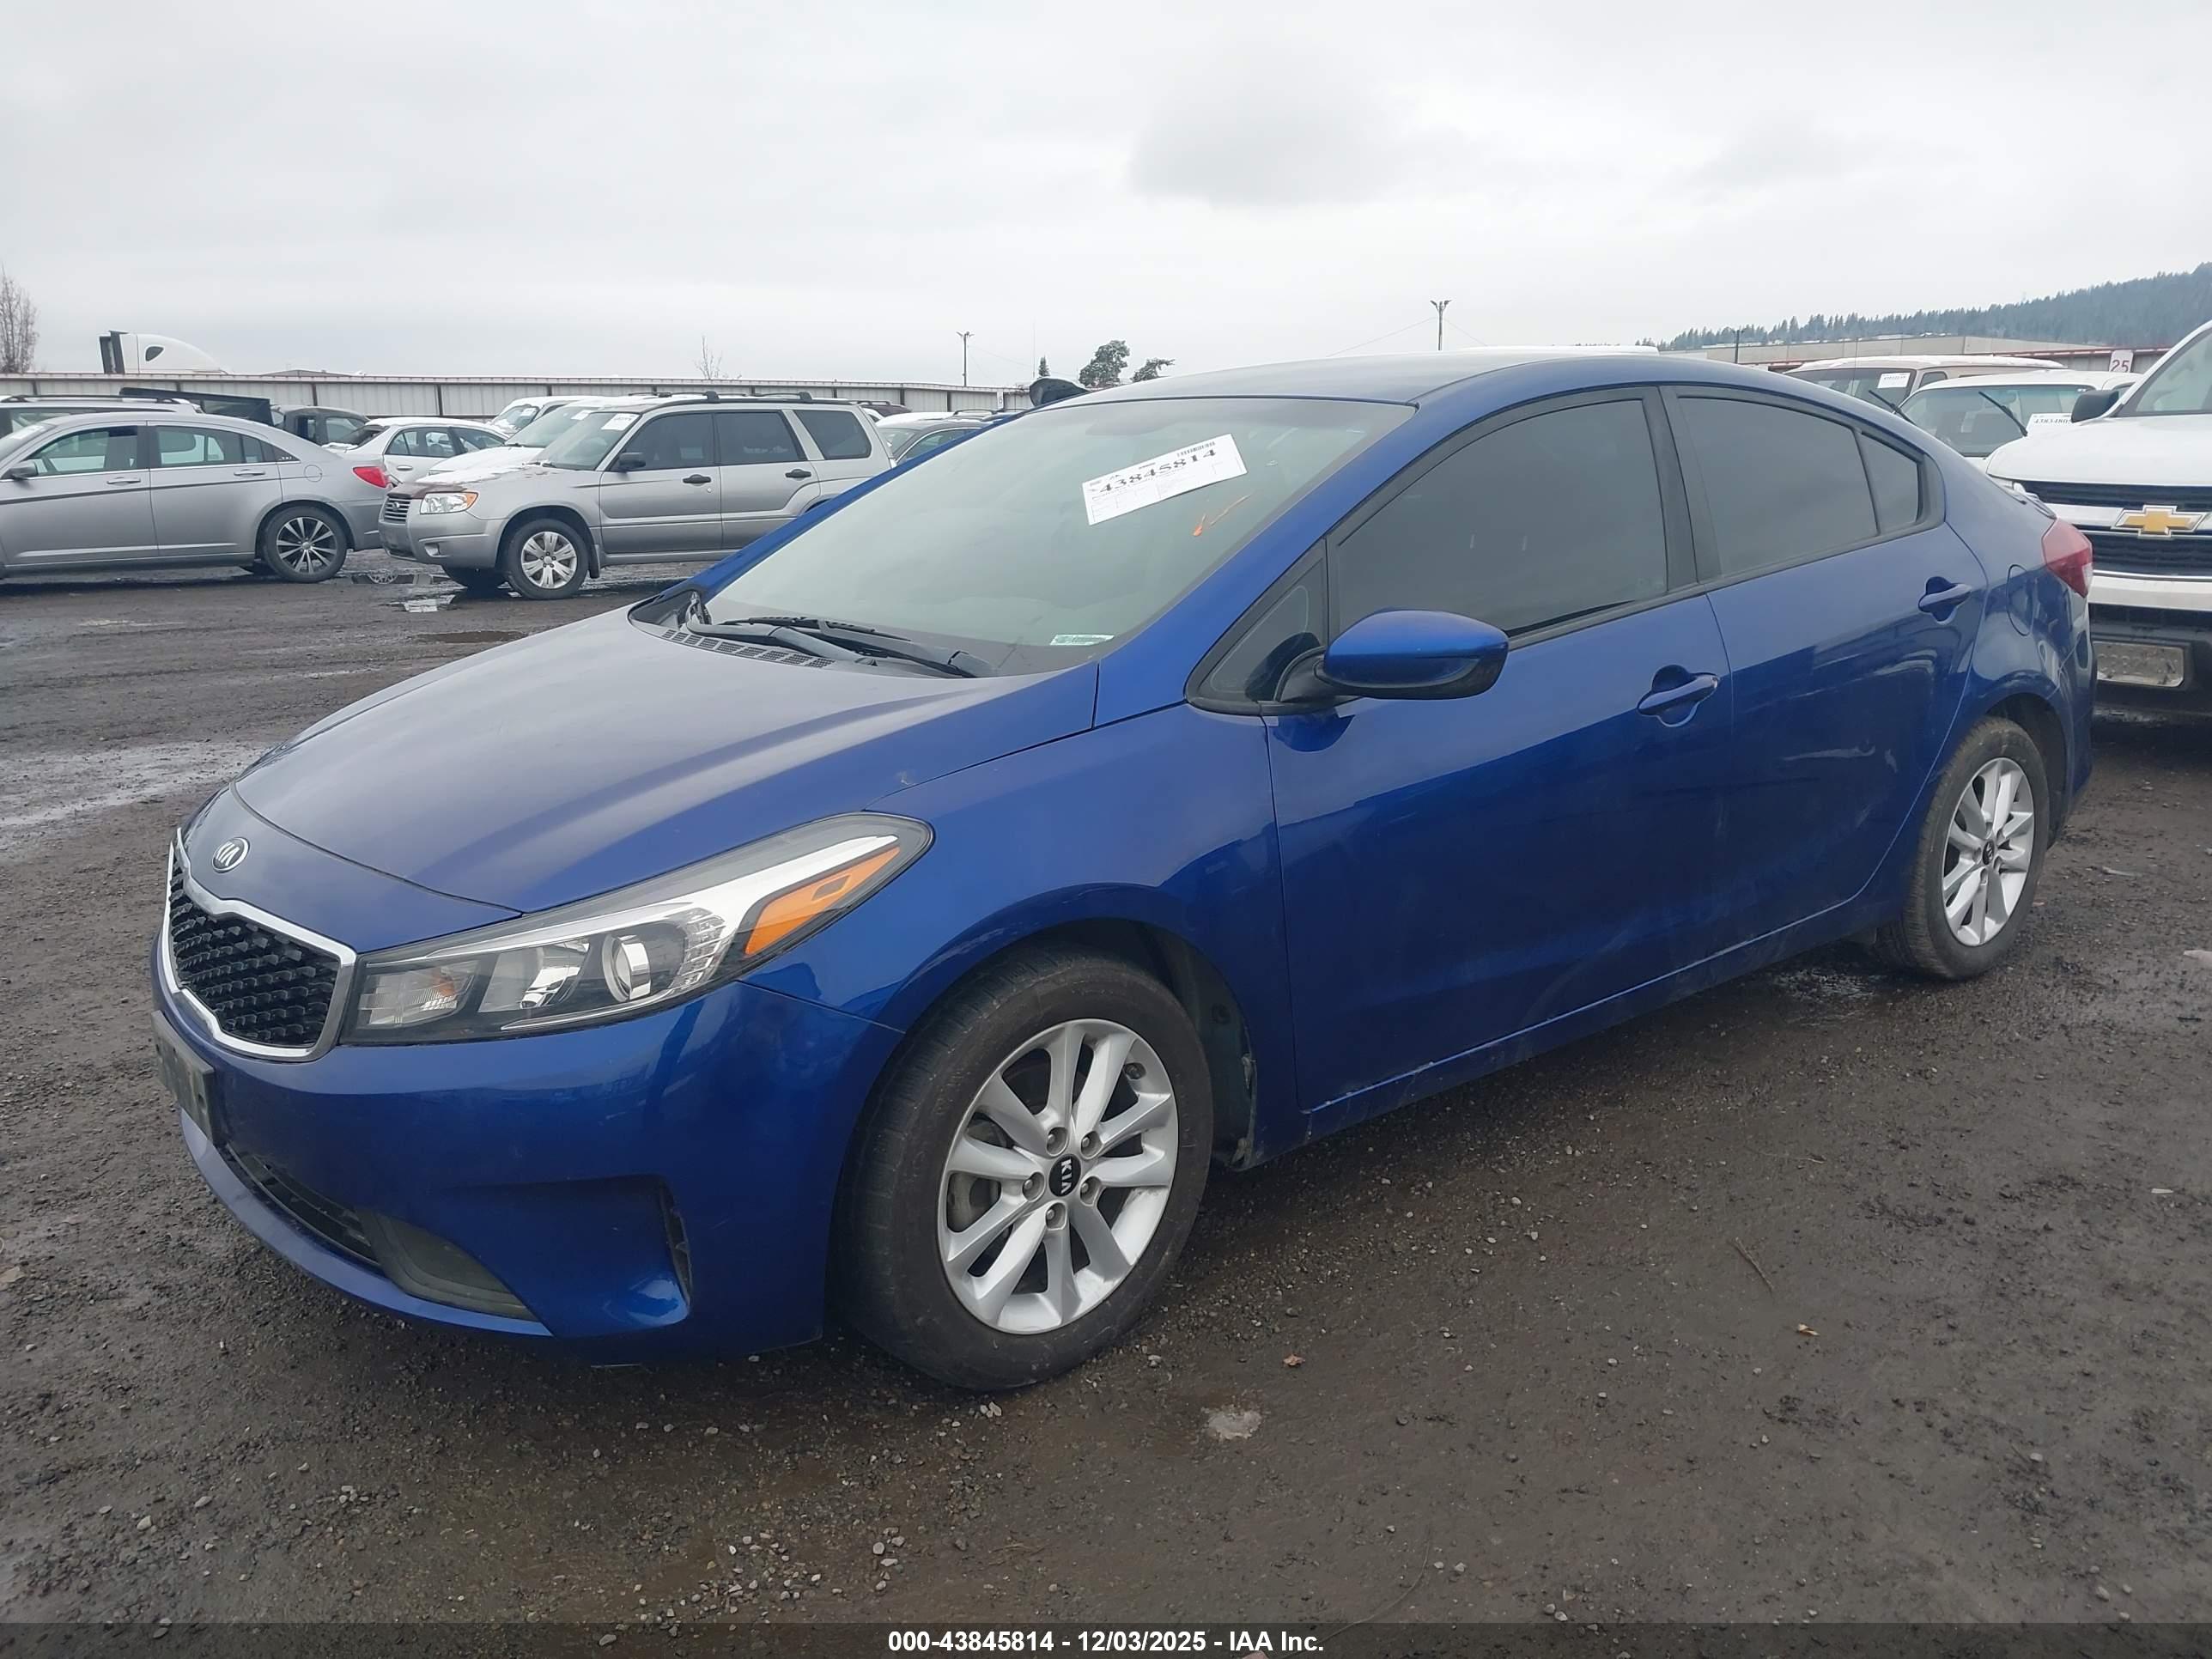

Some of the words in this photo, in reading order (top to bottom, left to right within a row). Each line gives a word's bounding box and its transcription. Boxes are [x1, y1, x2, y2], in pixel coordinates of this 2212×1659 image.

[2112, 359, 2130, 372] 25
[1099, 449, 1216, 492] 43845814
[1060, 1158, 1073, 1194] KIA
